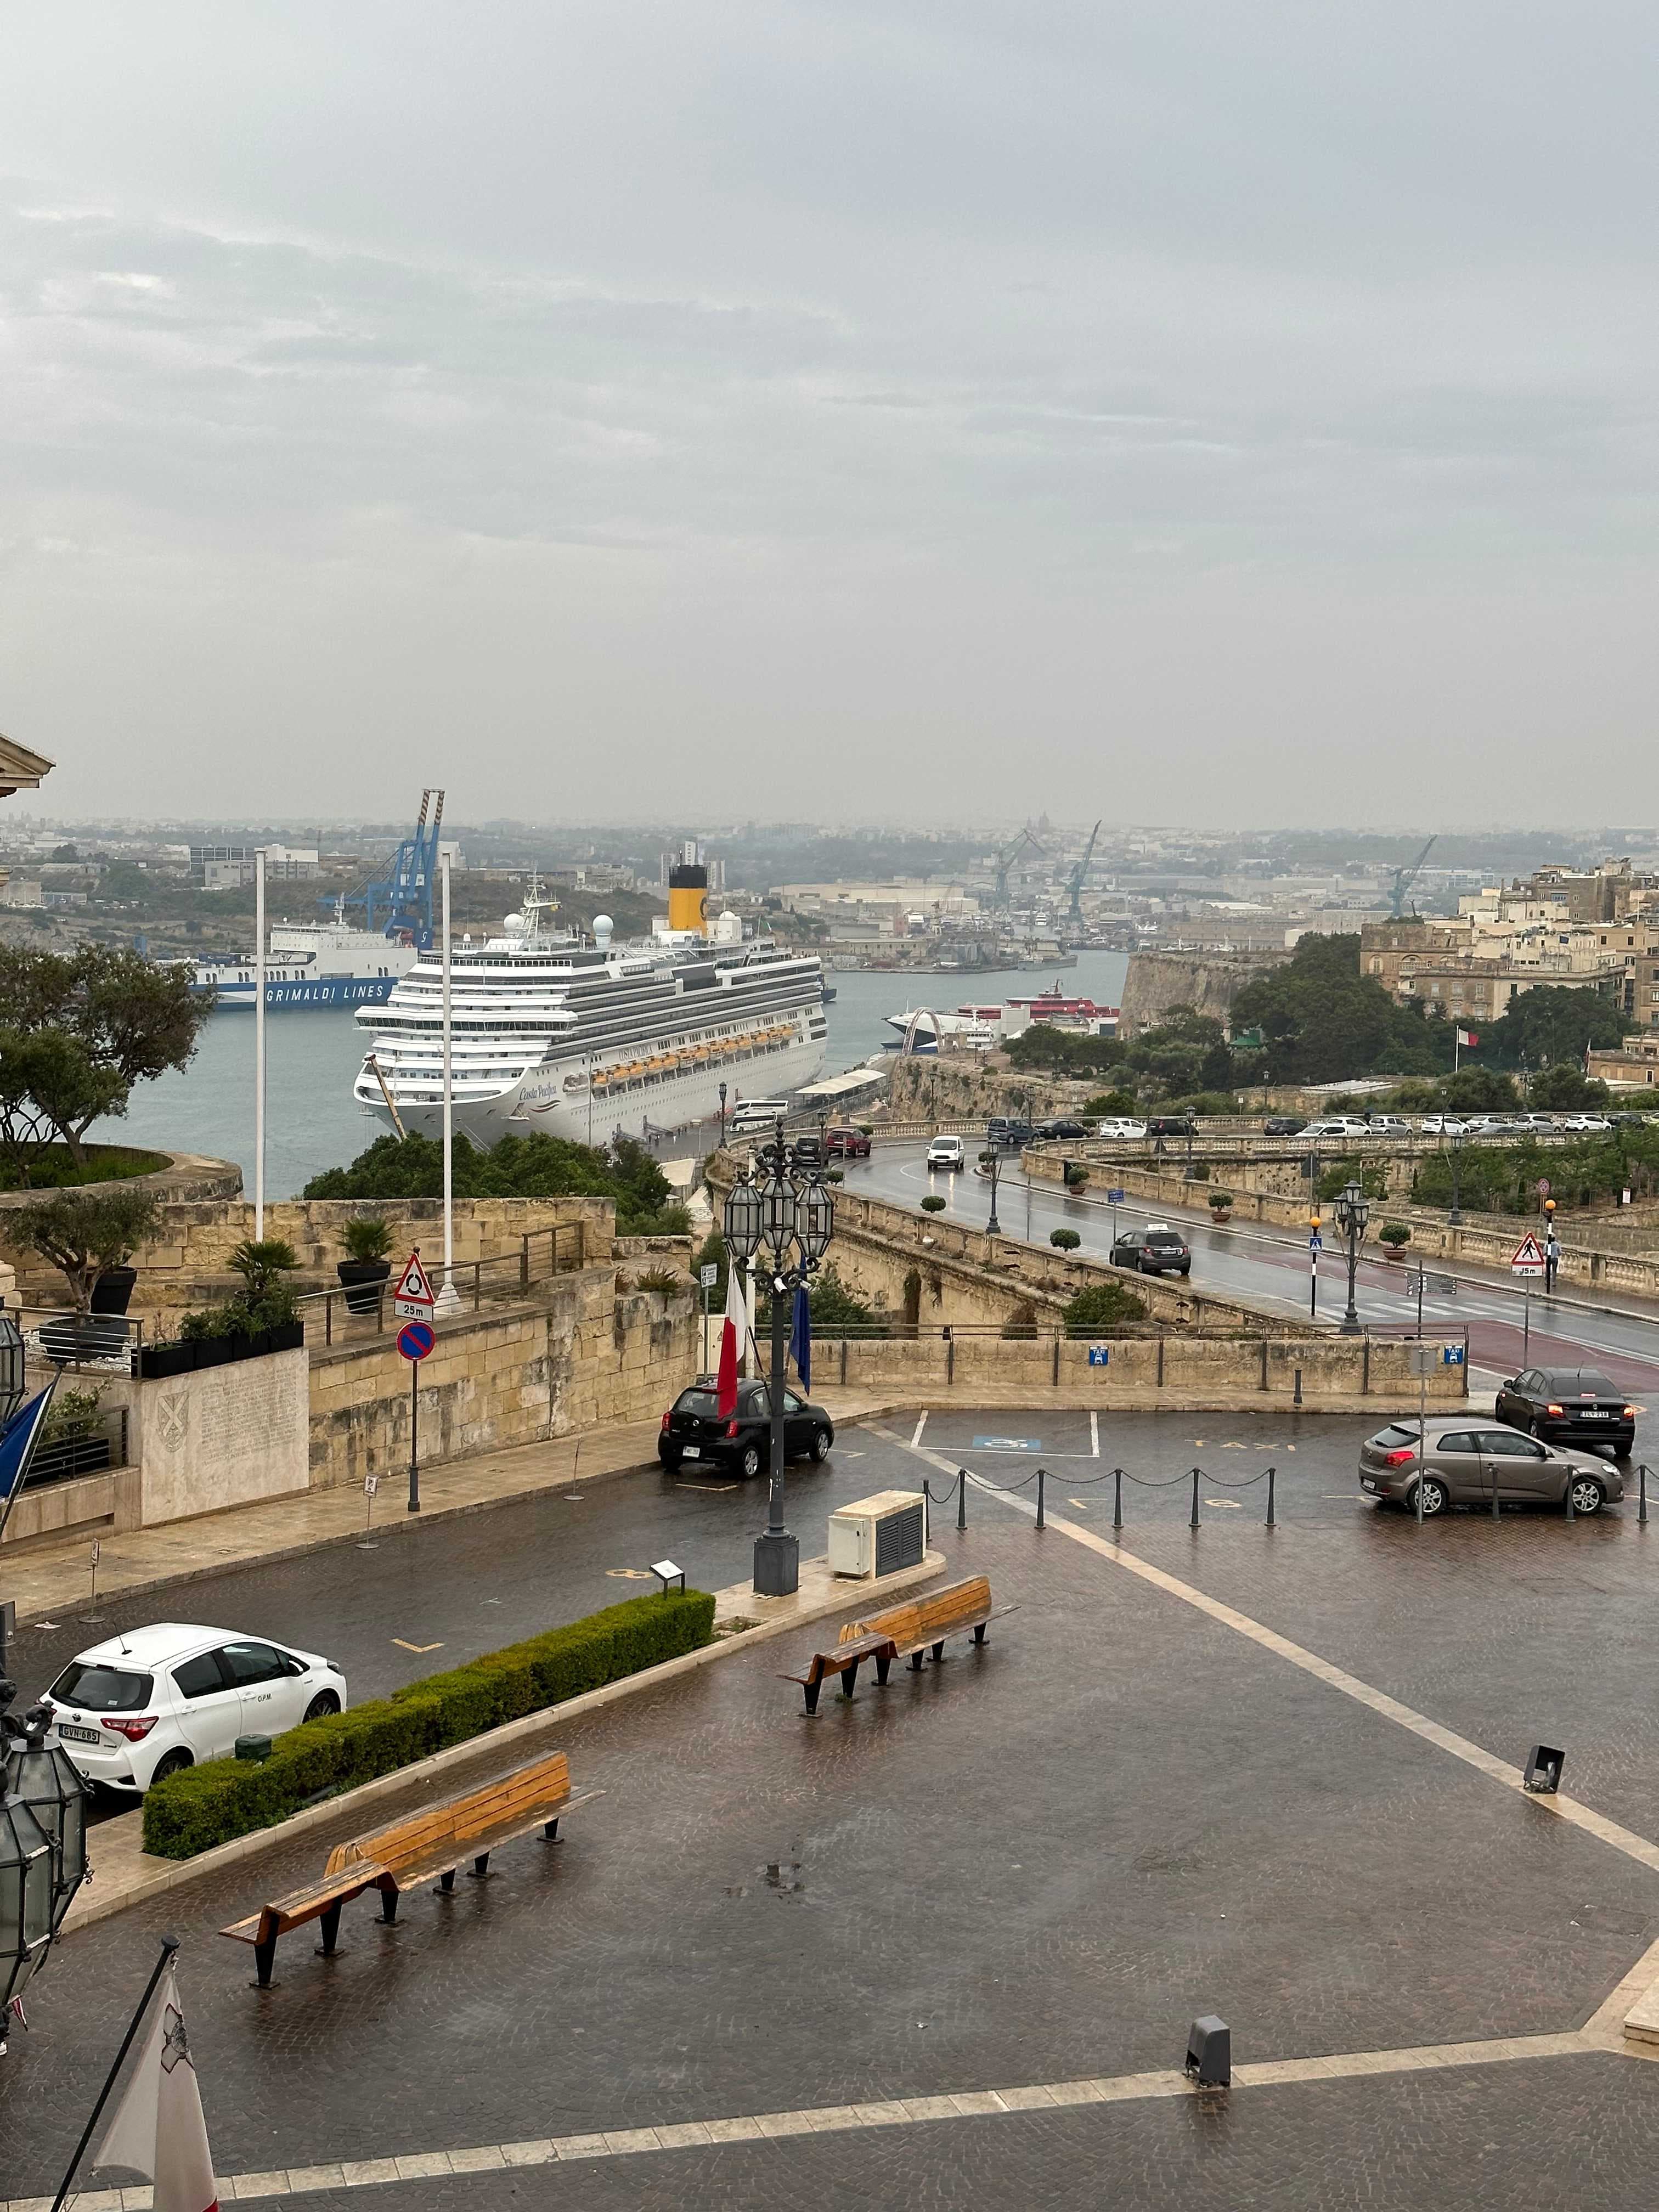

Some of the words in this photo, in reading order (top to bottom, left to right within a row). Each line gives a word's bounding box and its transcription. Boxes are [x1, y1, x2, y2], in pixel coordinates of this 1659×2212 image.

[267, 987, 335, 1002] GRIMALDI
[343, 985, 383, 998] LINES
[520, 1087, 538, 1101] Costa
[1184, 1439, 1296, 1451] TAXI
